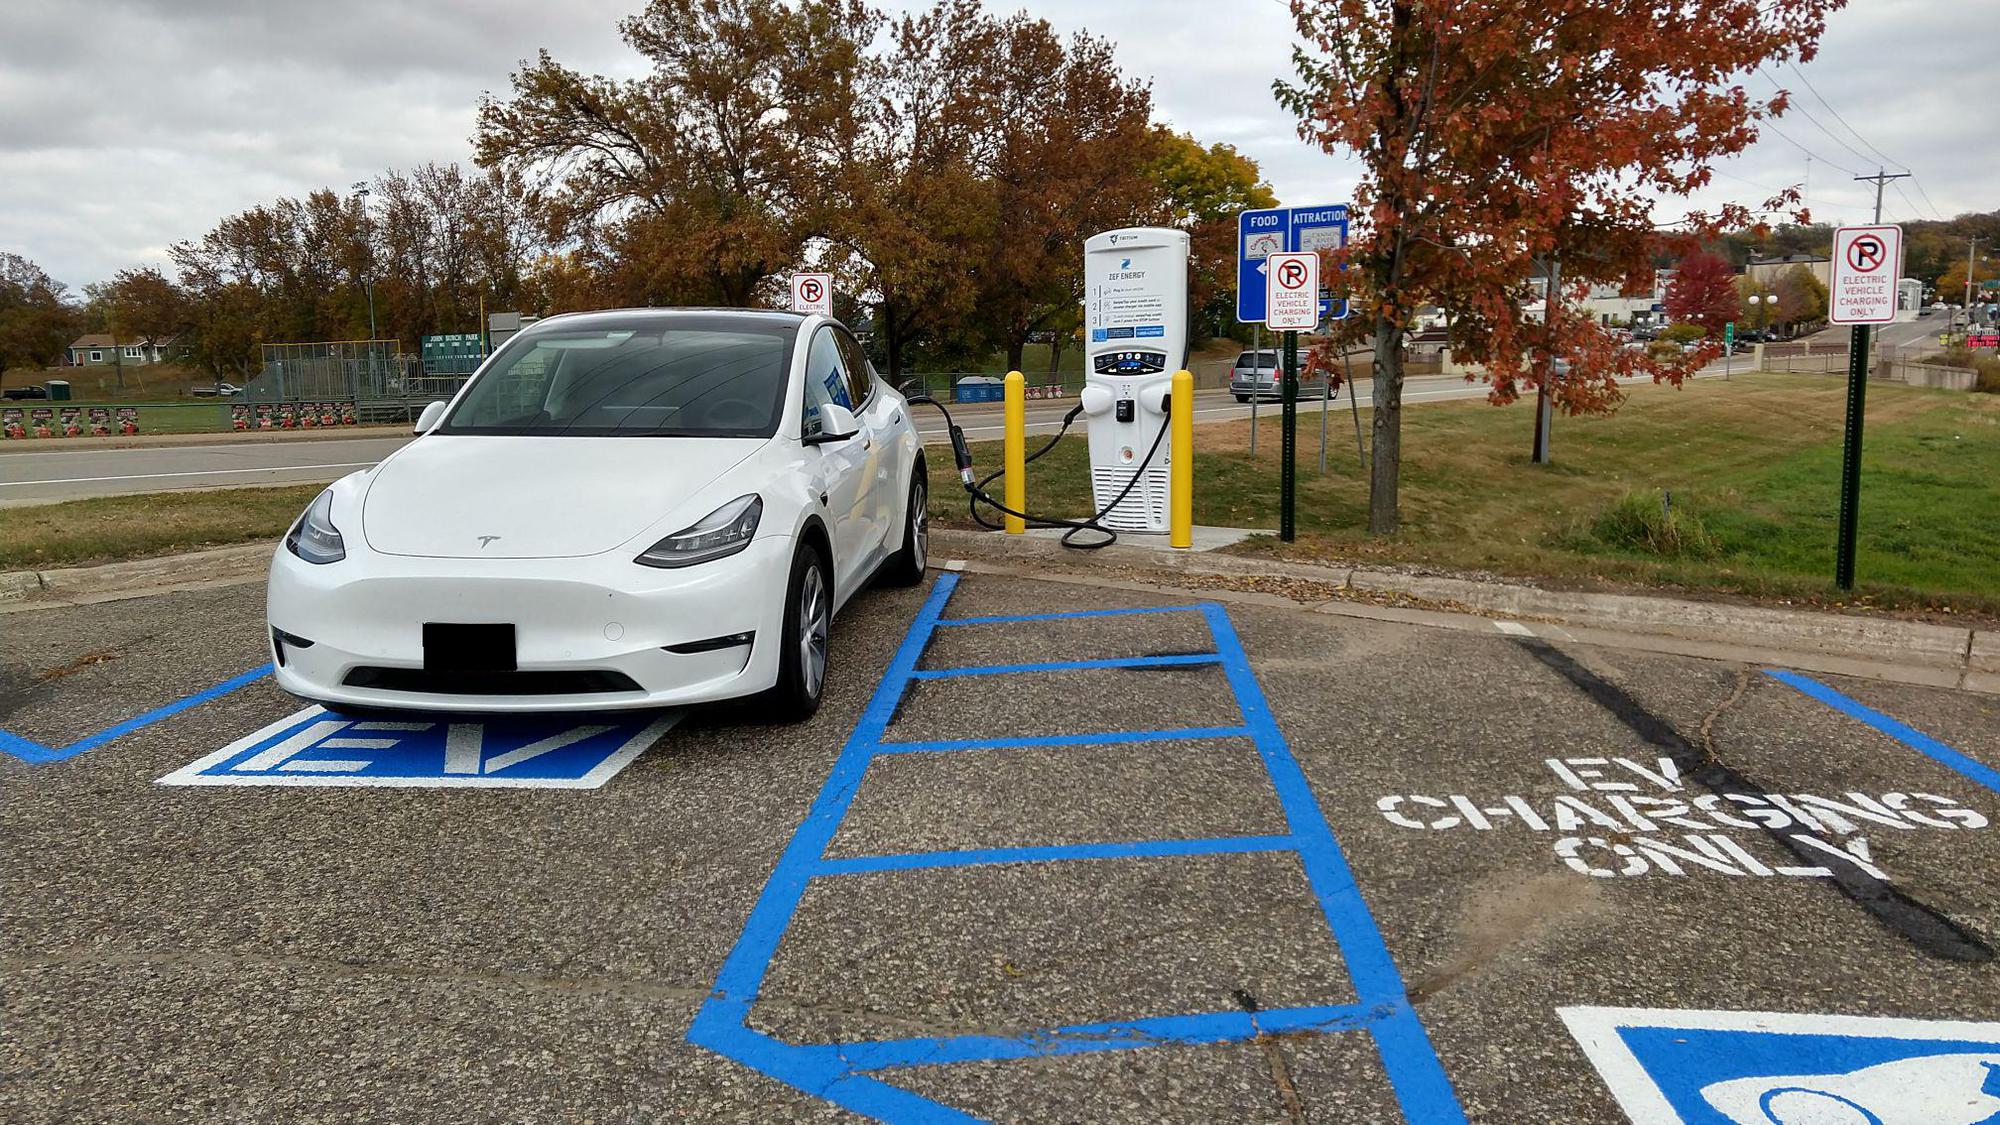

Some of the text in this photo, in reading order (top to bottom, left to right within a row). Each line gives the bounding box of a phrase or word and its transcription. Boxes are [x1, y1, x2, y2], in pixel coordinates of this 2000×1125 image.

[1250, 215, 1279, 227] FOOD
[1293, 210, 1348, 224] ATTRACTION
[1109, 271, 1146, 281] ZEF ENERGY
[1843, 275, 1887, 285] ELECTRIC
[1275, 291, 1309, 299] ELECTRIC
[1844, 286, 1883, 295] VEHICLE
[1840, 296, 1888, 306] CHARGING
[1092, 303, 1097, 311] 2
[1273, 308, 1311, 316] CHARGING
[1850, 307, 1876, 316] ONLY
[1092, 316, 1097, 325] 3
[465, 333, 478, 341] PARK
[230, 720, 622, 775] EV
[1545, 757, 1685, 792] EV
[1376, 792, 1988, 835] CHARGING
[1553, 834, 1890, 878] ONLY
